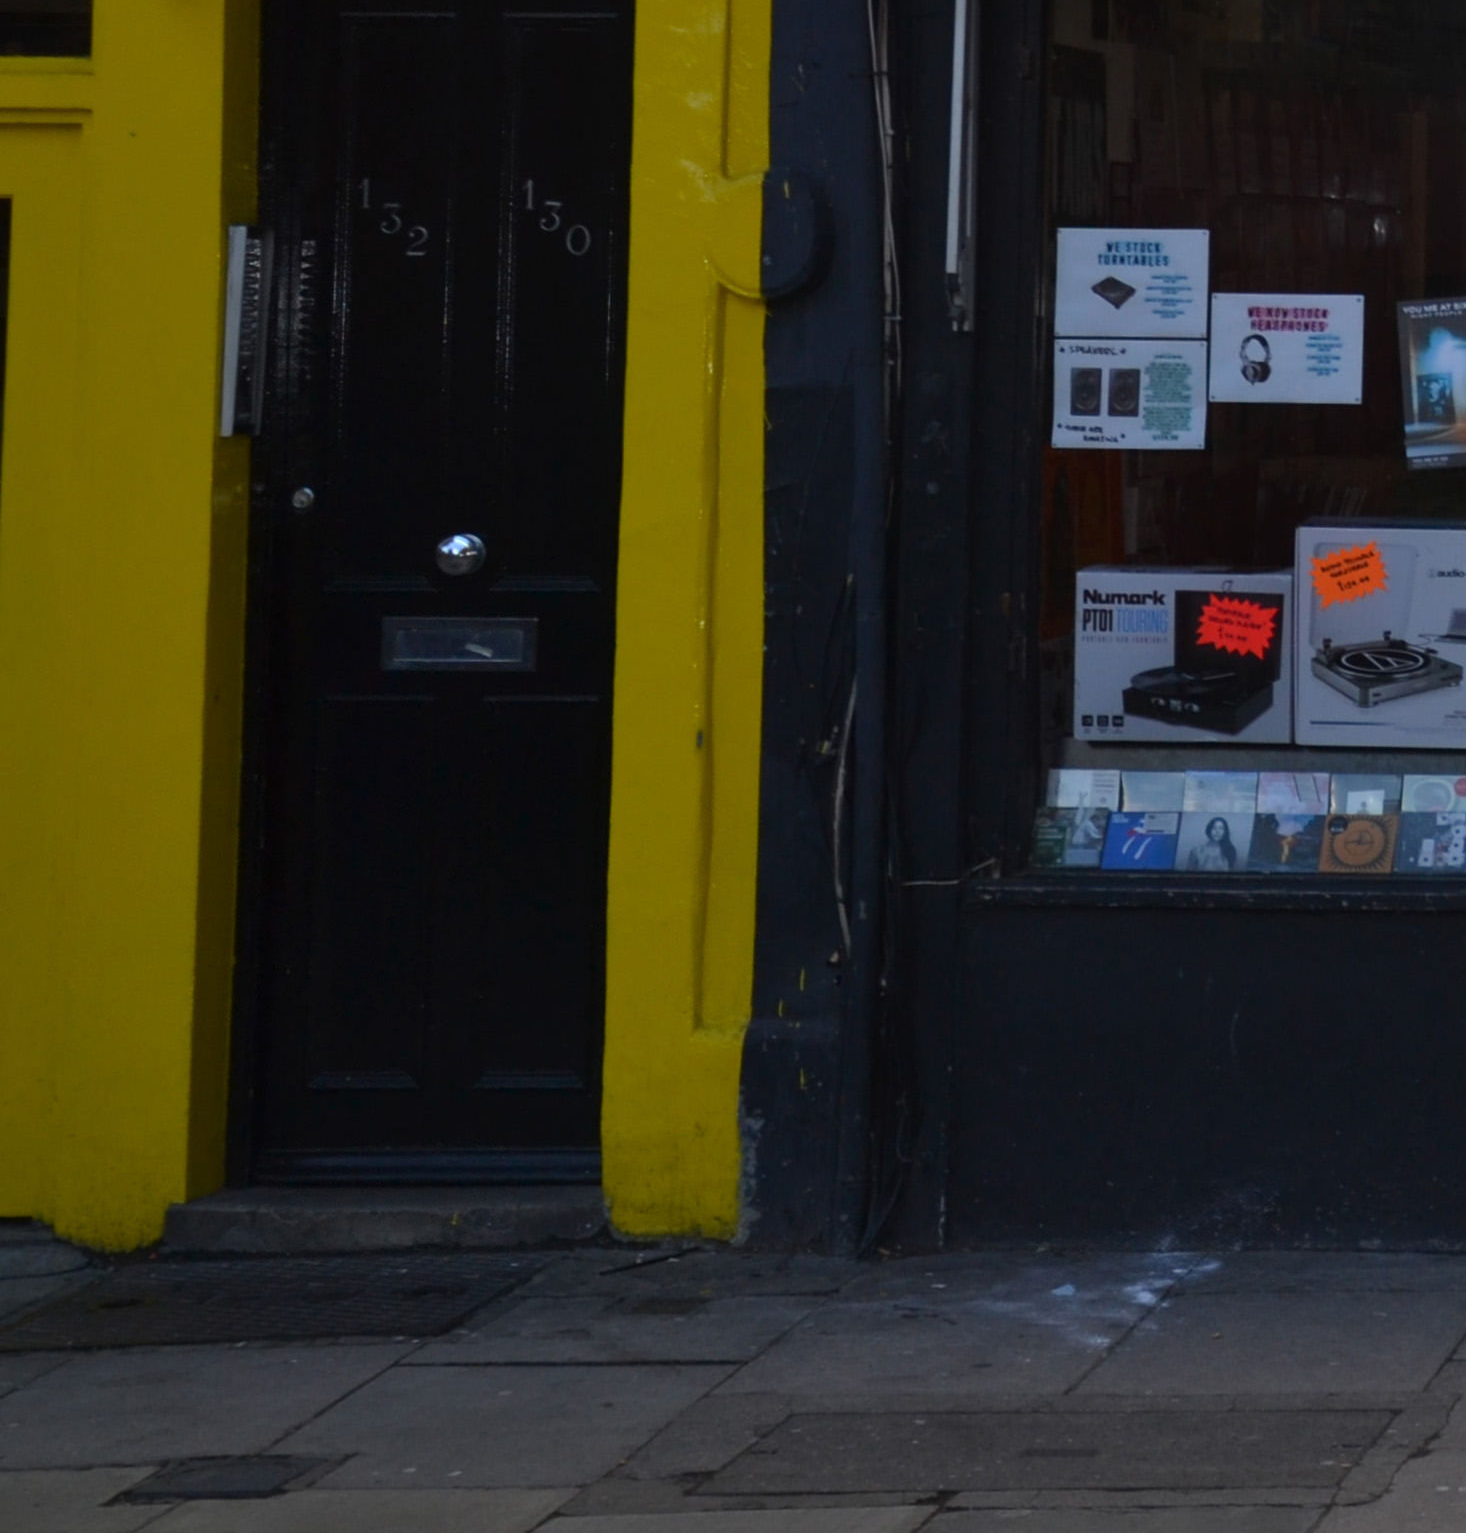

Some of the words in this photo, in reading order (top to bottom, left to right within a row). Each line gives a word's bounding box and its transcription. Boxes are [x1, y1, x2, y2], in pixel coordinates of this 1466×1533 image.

[359, 177, 429, 257] 132
[522, 178, 592, 257] 130
[1106, 242, 1120, 253] WE
[1126, 242, 1161, 253] STOCK
[1098, 254, 1169, 267] TURNTABLES
[1293, 308, 1329, 319] STOCK
[1402, 305, 1422, 315] YOU
[1424, 304, 1438, 313] ME
[1439, 303, 1451, 312] AT
[1250, 320, 1326, 332] HEADPHONES
[1083, 589, 1166, 605] Numark
[1082, 608, 1113, 632] PT01
[1116, 609, 1169, 634] TOURING
